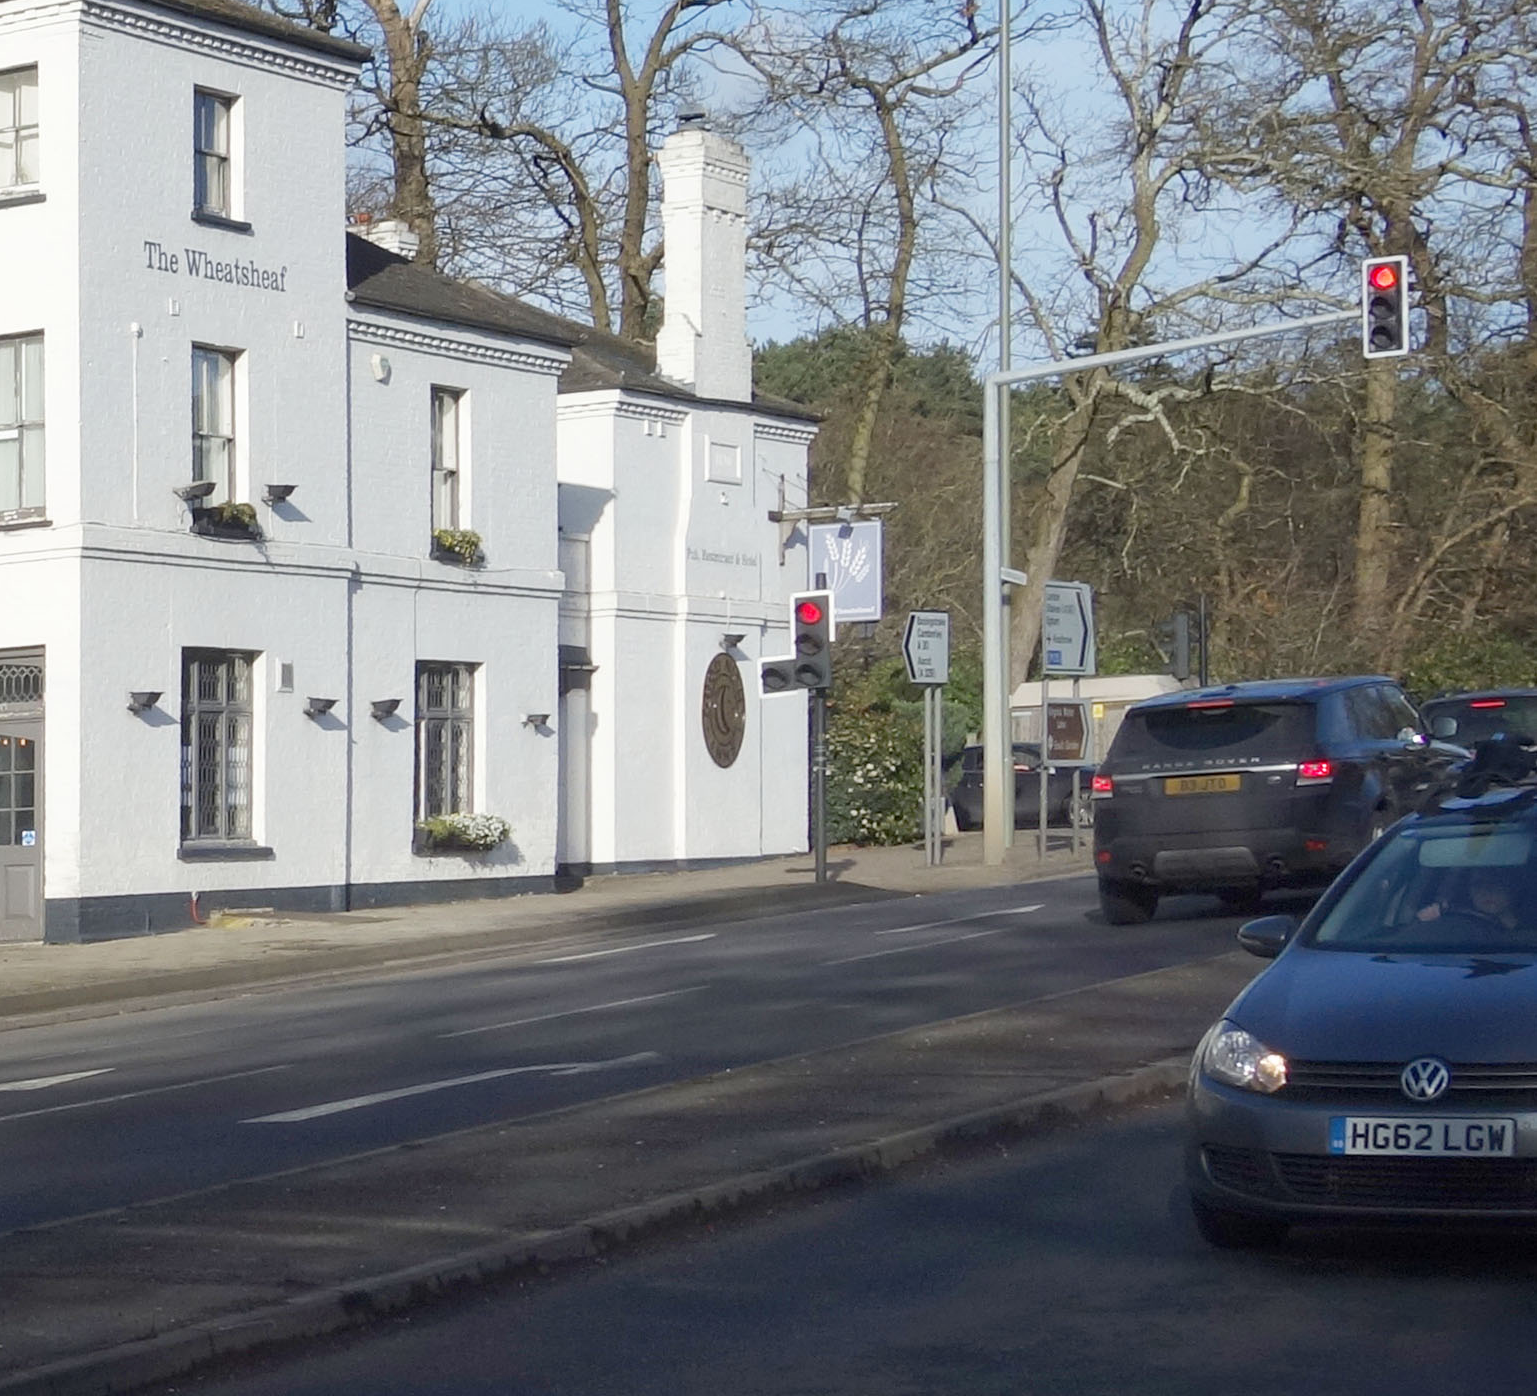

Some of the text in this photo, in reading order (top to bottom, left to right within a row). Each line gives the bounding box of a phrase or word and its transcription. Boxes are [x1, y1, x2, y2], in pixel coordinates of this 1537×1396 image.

[144, 240, 287, 292] The Wheatsheaf
[1203, 756, 1261, 766] ROVER
[1351, 1122, 1506, 1152] HG62 LGW
